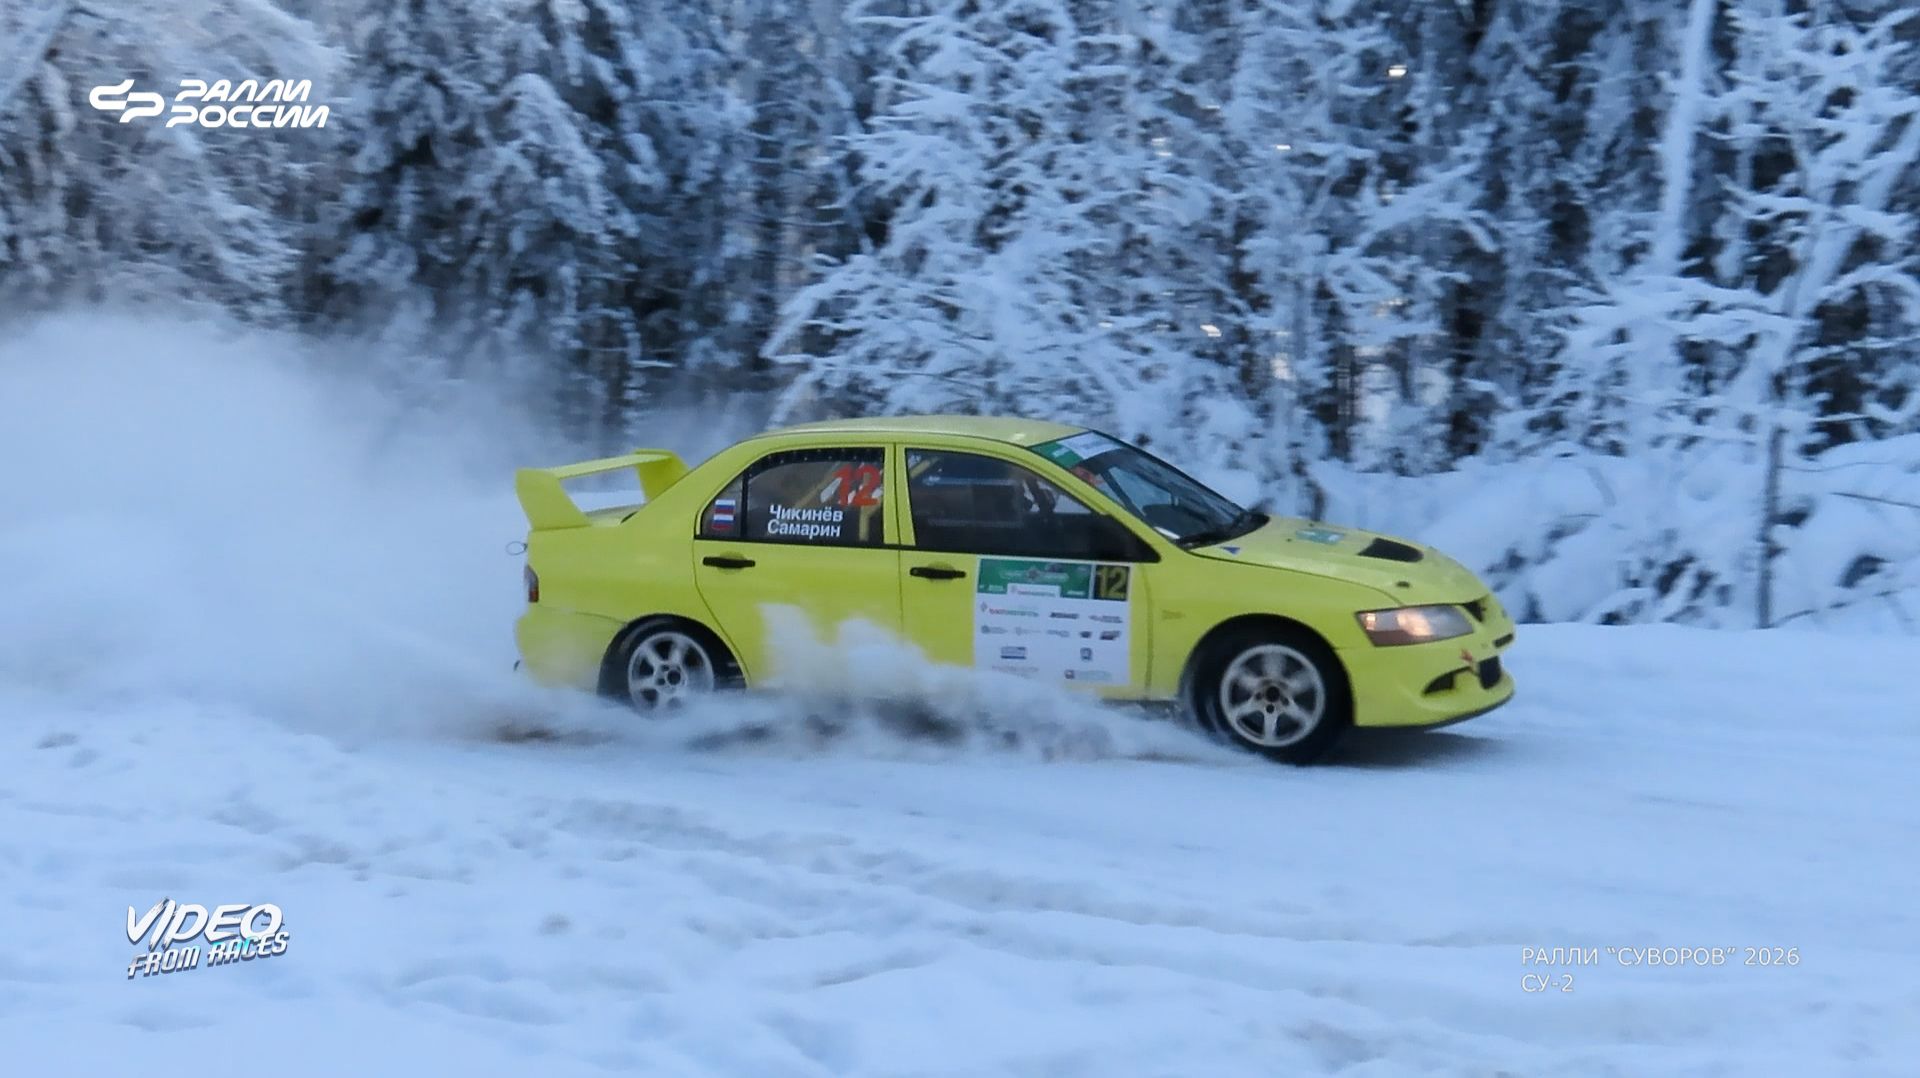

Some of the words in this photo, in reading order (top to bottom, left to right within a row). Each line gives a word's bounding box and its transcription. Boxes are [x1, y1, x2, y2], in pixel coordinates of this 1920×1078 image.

[831, 463, 881, 507] 12
[769, 504, 844, 522] Чикинёв
[767, 518, 841, 539] Самарин
[1095, 566, 1128, 599] 12
